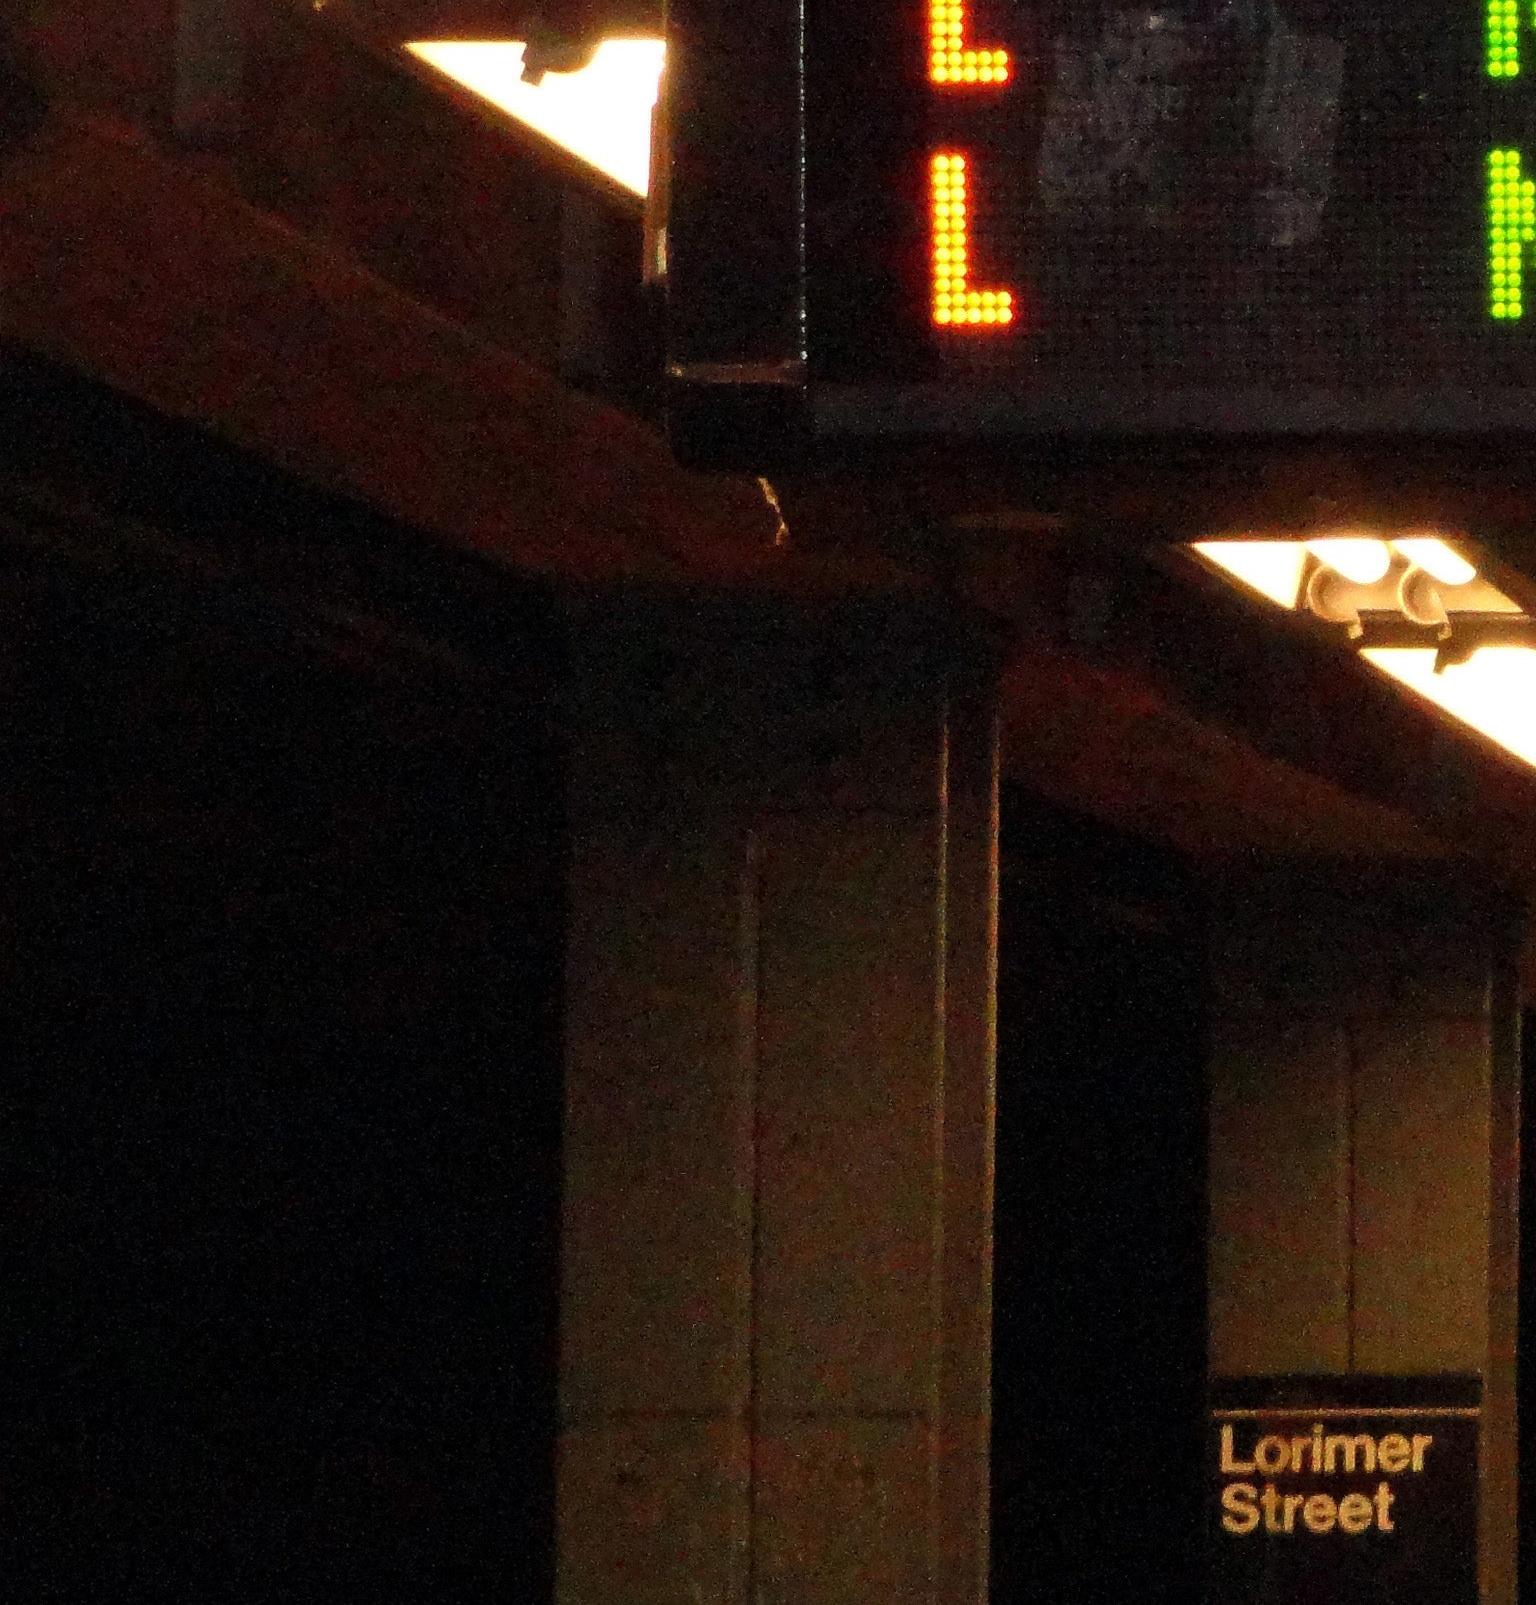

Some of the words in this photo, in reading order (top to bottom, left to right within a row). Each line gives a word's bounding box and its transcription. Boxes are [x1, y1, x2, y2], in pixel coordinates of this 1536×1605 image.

[929, 152, 1014, 327] L
[1219, 1422, 1434, 1474] Lorimer
[1219, 1481, 1395, 1534] Street
